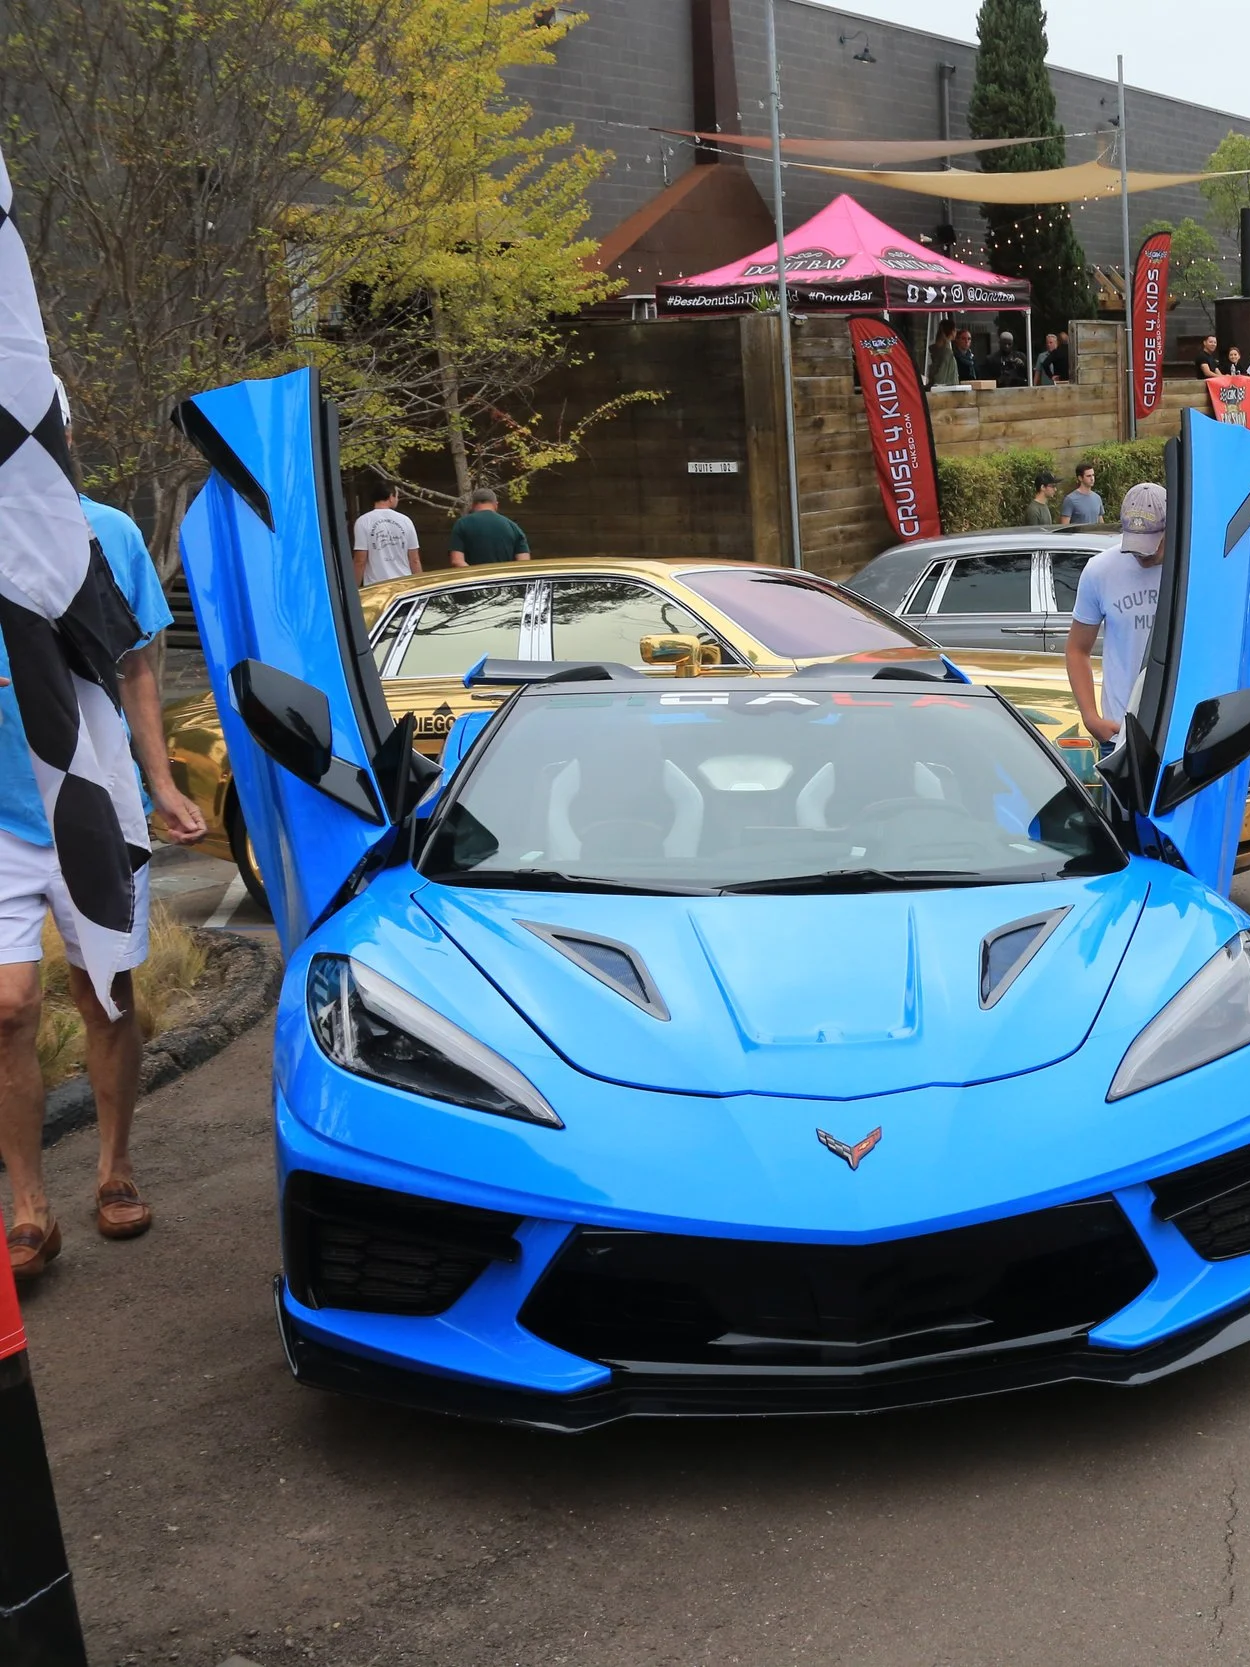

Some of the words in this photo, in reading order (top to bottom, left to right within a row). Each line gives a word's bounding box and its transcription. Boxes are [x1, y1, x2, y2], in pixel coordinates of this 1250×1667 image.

[743, 260, 807, 276] DOUT
[806, 258, 846, 271] BAR
[808, 289, 873, 303] #DonutBar
[1146, 269, 1159, 313] KIDS
[1145, 320, 1156, 332] 4
[872, 360, 901, 419] KIDS
[1144, 338, 1158, 408] CRUISE
[884, 414, 904, 444] 4
[904, 413, 919, 470] C4KSD.COM
[694, 463, 713, 473] SUITE
[719, 463, 731, 472] 102
[888, 448, 920, 537] CRUISE
